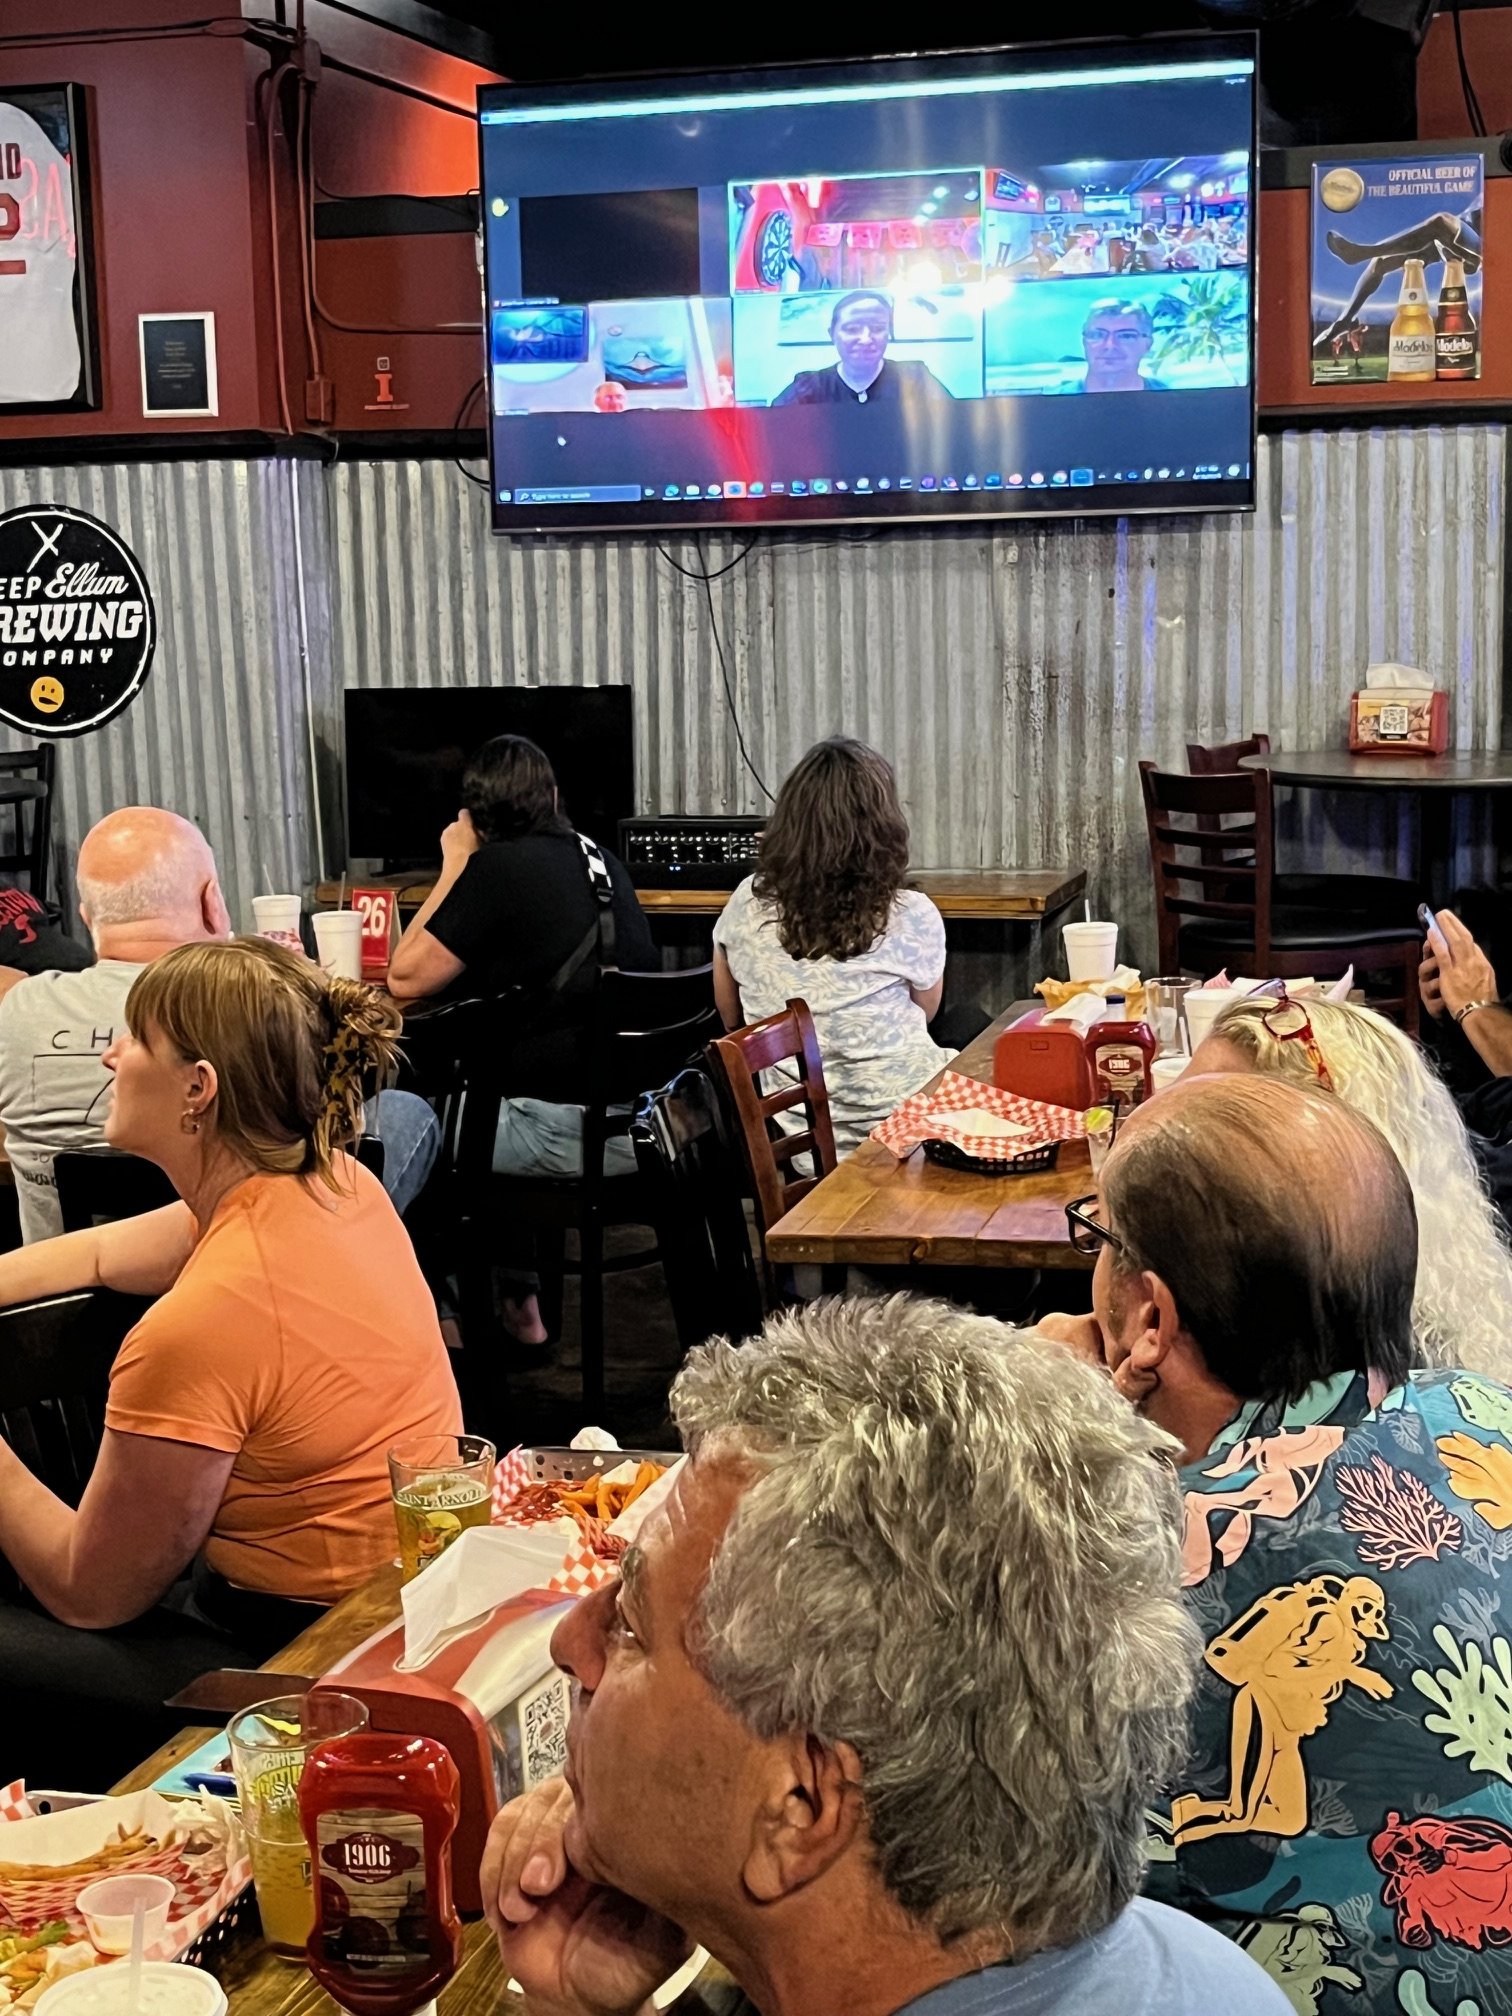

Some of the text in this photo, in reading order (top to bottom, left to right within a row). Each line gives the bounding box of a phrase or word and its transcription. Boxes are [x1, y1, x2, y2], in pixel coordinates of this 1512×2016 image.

[1388, 165, 1476, 181] OFFICIAL BEER OF
[1367, 185, 1386, 197] THE
[1389, 182, 1442, 196] BEAUTIFUL
[1444, 180, 1474, 193] GAME
[44, 562, 129, 598] Ellum
[357, 895, 386, 938] 26
[396, 1491, 428, 1506] SAINT
[344, 1843, 391, 1867] 1906
